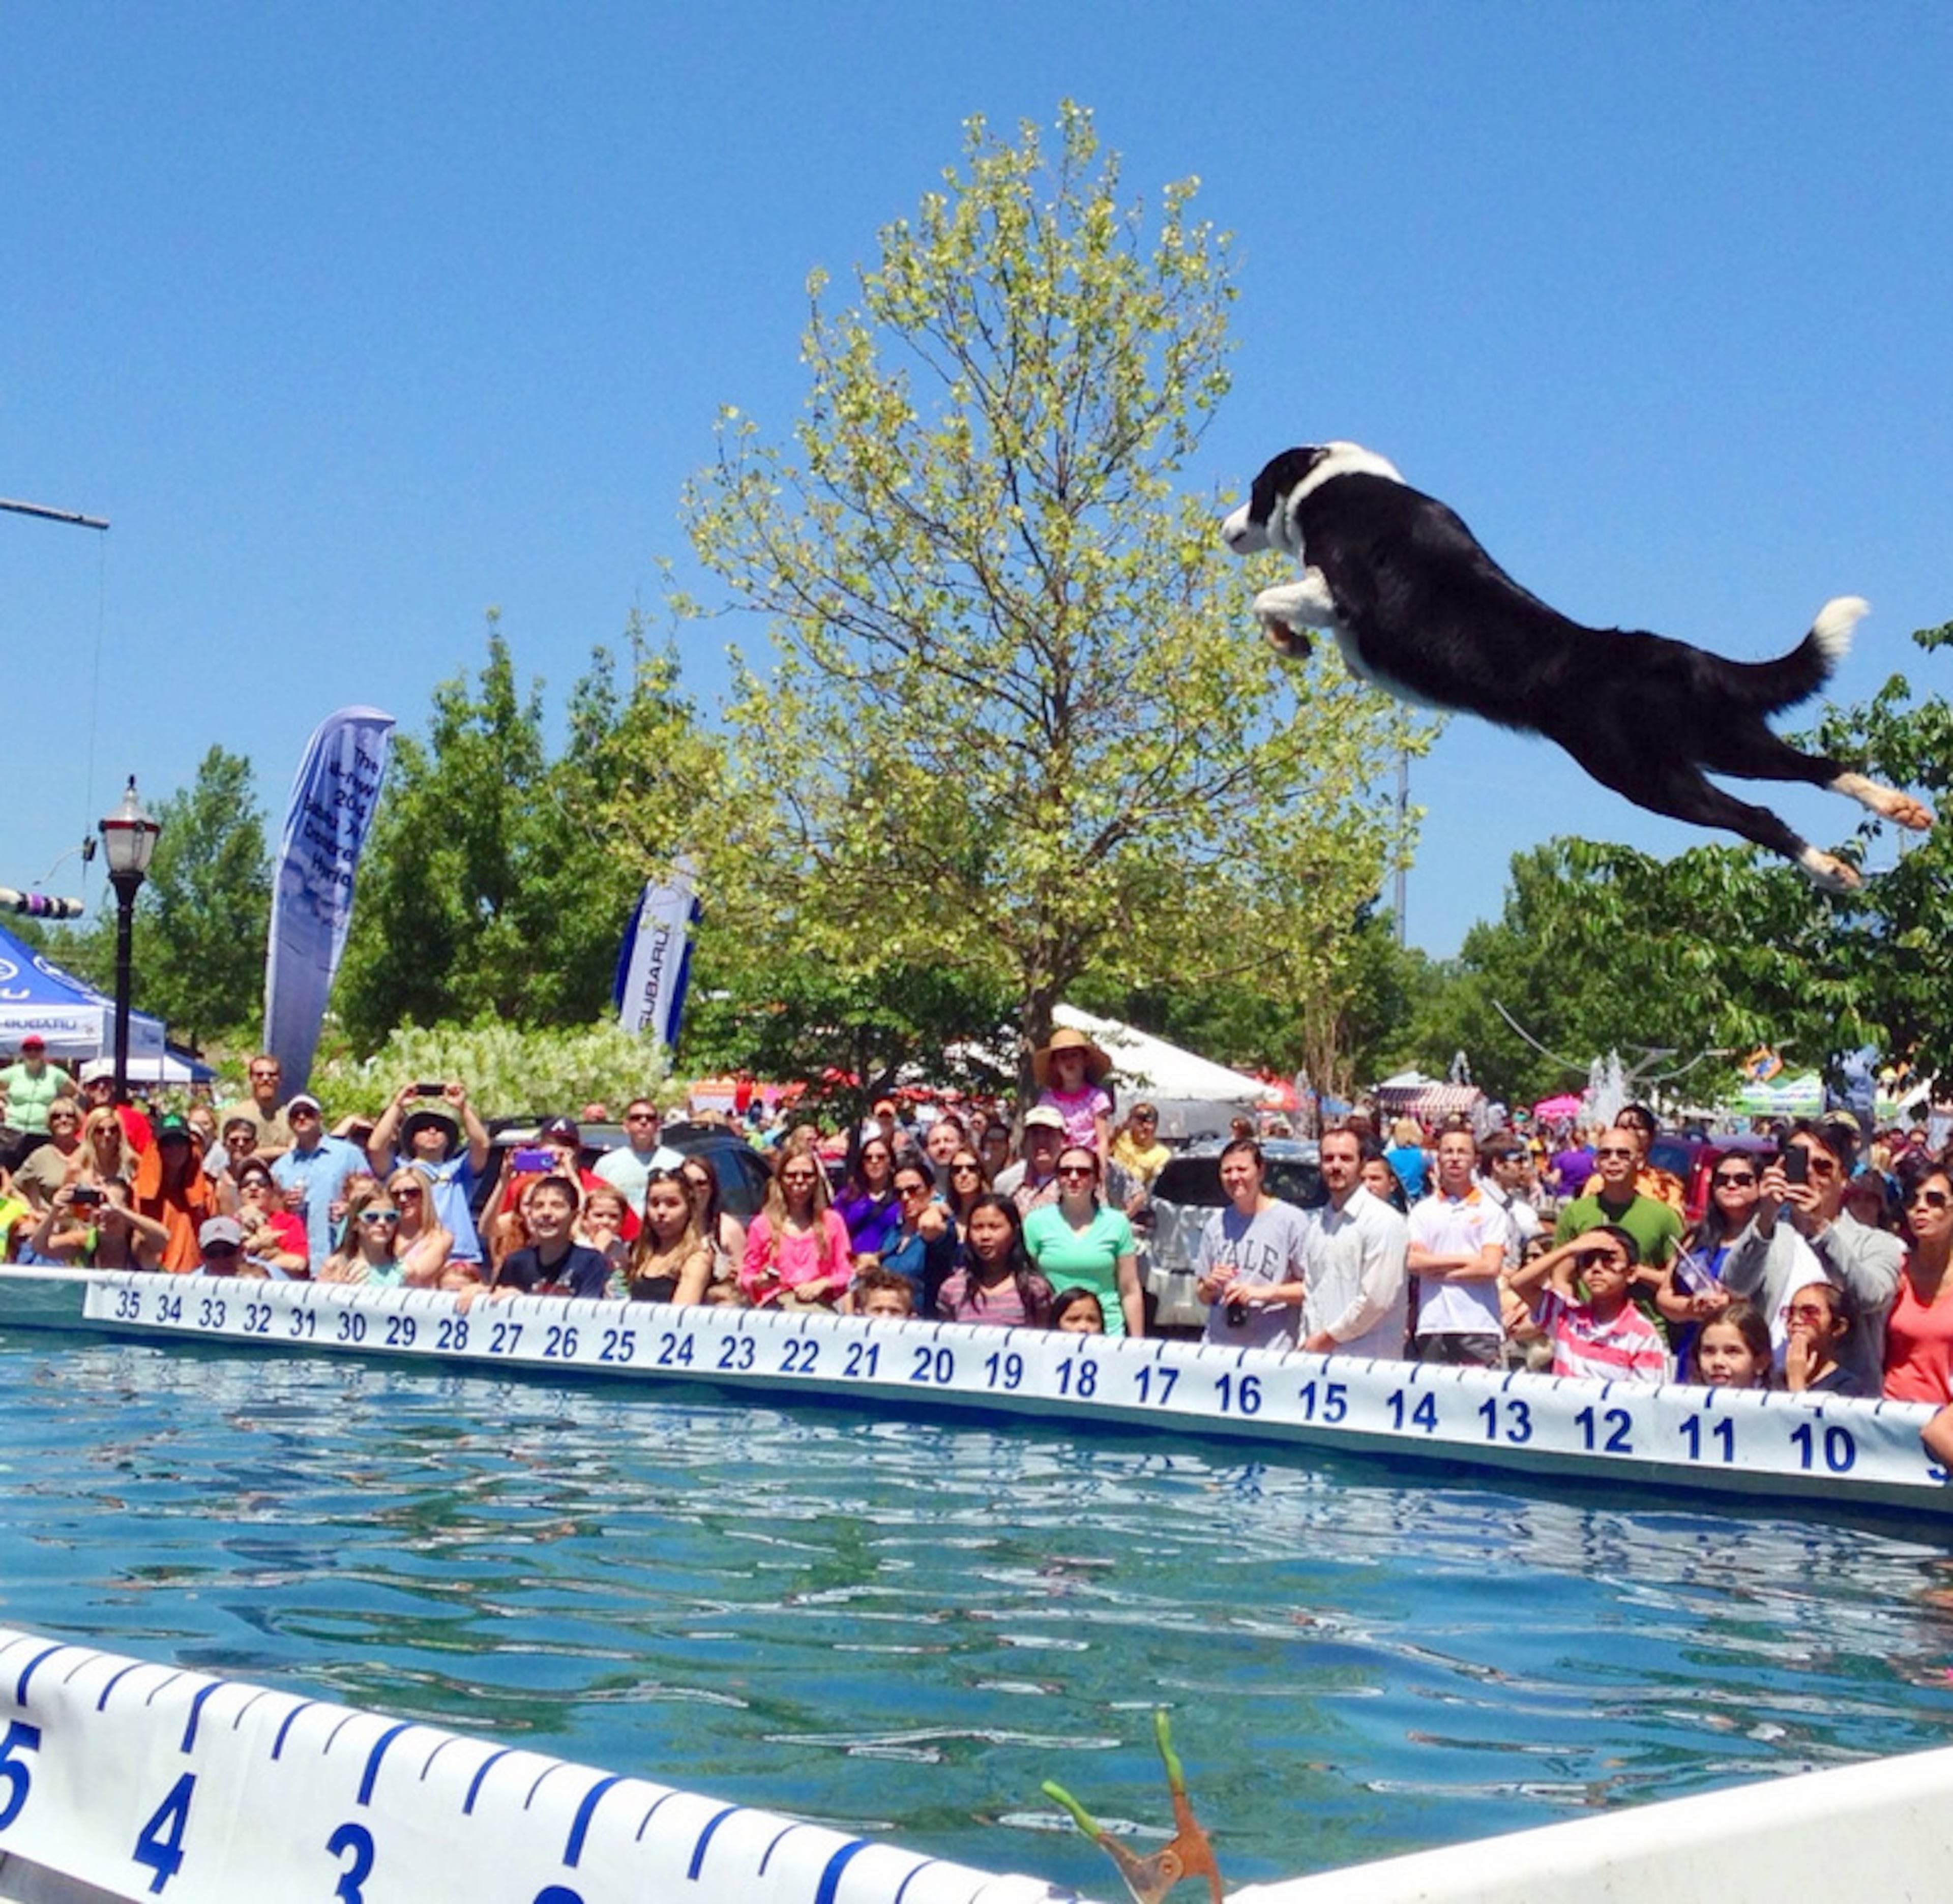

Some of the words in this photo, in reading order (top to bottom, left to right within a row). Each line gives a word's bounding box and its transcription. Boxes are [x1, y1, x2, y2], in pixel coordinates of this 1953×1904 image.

[4, 1018, 76, 1031] SUBARU
[638, 922, 670, 1031] SUBARU
[116, 1290, 140, 1319] 35
[157, 1294, 181, 1322] 34
[199, 1299, 226, 1327] 33
[244, 1303, 272, 1332] 32
[290, 1307, 316, 1335] 31
[338, 1311, 367, 1342] 30
[386, 1316, 416, 1346] 29
[437, 1317, 469, 1350] 28
[489, 1323, 523, 1352] 27
[544, 1326, 578, 1357] 26
[600, 1329, 635, 1362] 25
[658, 1332, 693, 1365] 24
[718, 1335, 755, 1369] 23
[780, 1339, 819, 1373] 22
[844, 1343, 879, 1377] 21
[910, 1347, 954, 1383] 20
[986, 1352, 1023, 1389] 19
[1057, 1358, 1098, 1397] 18
[1135, 1365, 1179, 1404] 17
[1215, 1373, 1261, 1414] 16
[1299, 1381, 1347, 1422] 15
[1386, 1389, 1438, 1433] 14
[1478, 1397, 1532, 1443] 13
[1574, 1406, 1633, 1453] 12
[1679, 1414, 1734, 1462] 11
[1789, 1422, 1856, 1472] 10
[0, 1719, 41, 1831] 5
[132, 1772, 197, 1895] 4
